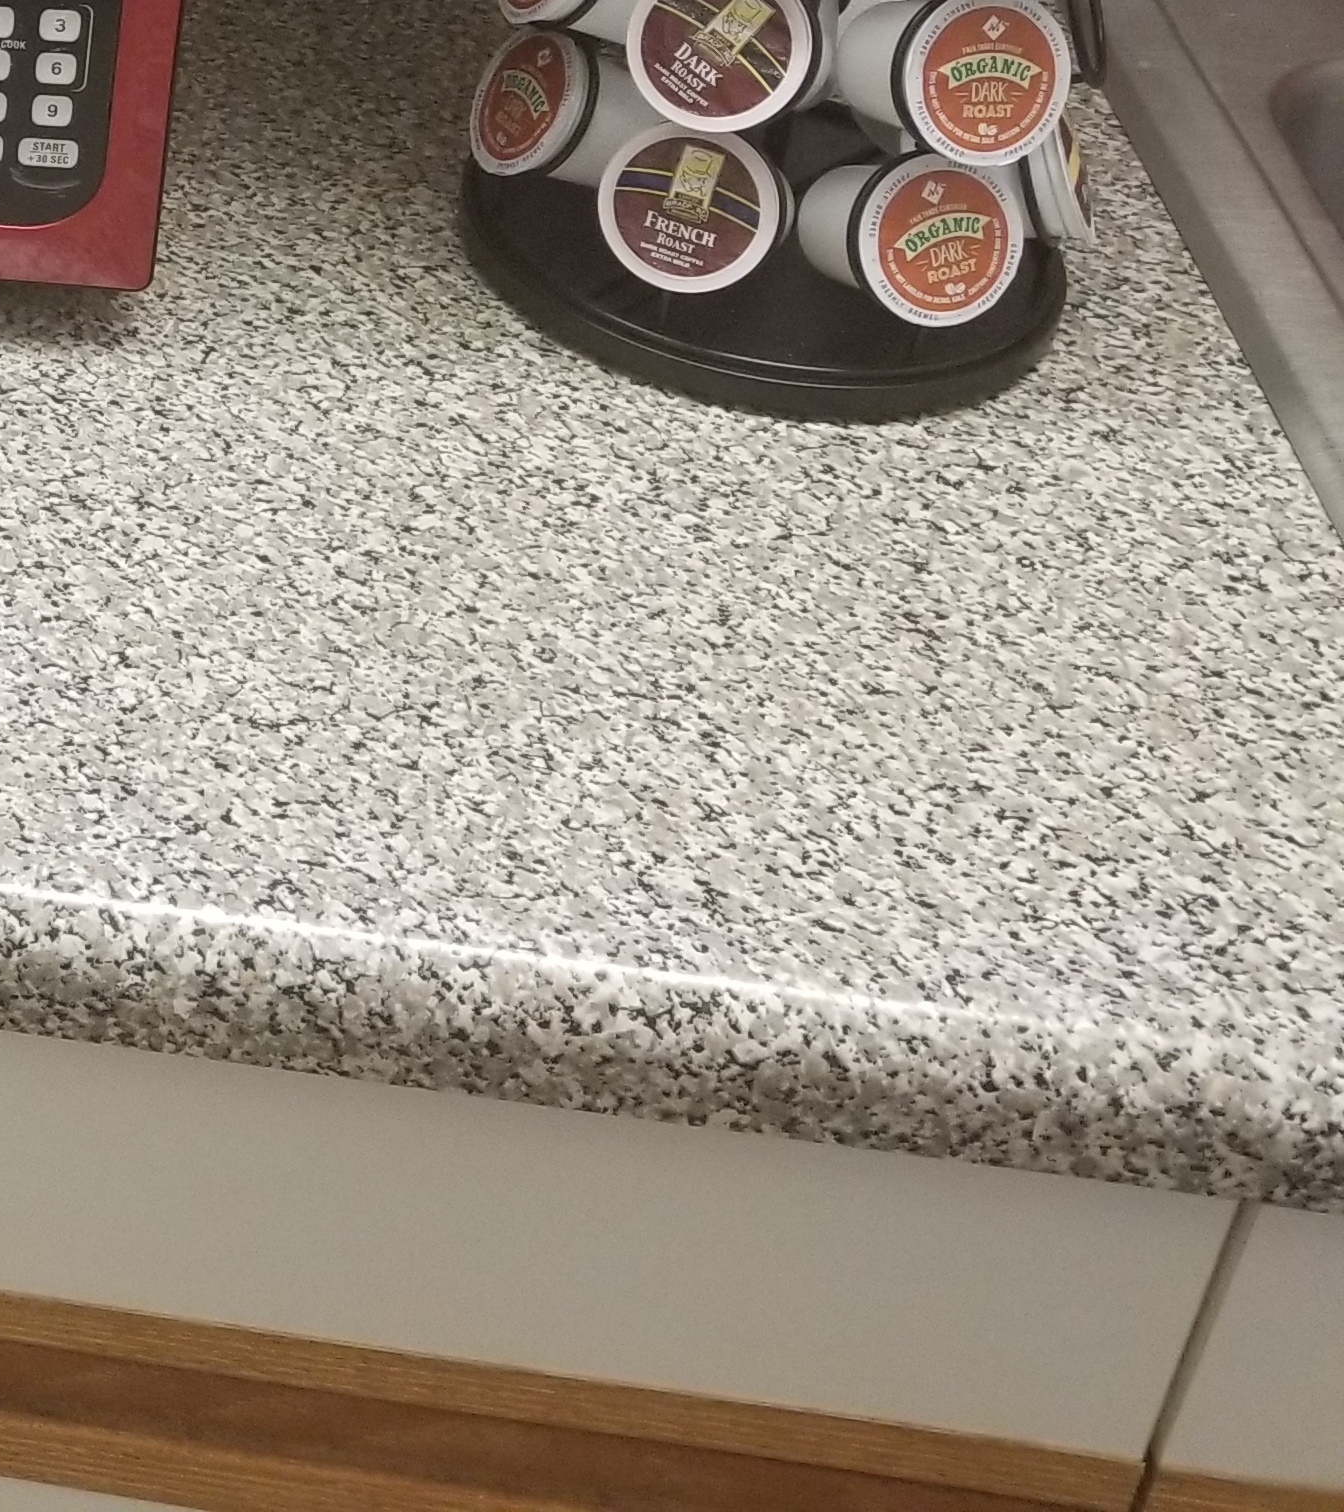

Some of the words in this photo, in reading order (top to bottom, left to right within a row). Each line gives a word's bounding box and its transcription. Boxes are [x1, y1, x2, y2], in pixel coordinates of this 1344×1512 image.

[54, 19, 66, 33] 3
[0, 39, 27, 50] COOK
[51, 62, 62, 75] 6
[673, 41, 724, 87] DARK
[950, 55, 1032, 83] ORGANIC
[670, 61, 706, 92] ROAST
[971, 82, 1009, 103] DARK
[47, 104, 58, 118] 9
[962, 104, 1014, 118] ROAST
[32, 142, 66, 152] START
[28, 154, 47, 164] +30
[50, 155, 70, 165] SEC
[643, 209, 717, 248] FRENCH
[904, 216, 981, 254] ORGANIC
[656, 231, 696, 255] ROAST
[929, 240, 969, 267] DARK
[926, 258, 977, 284] ROAST
